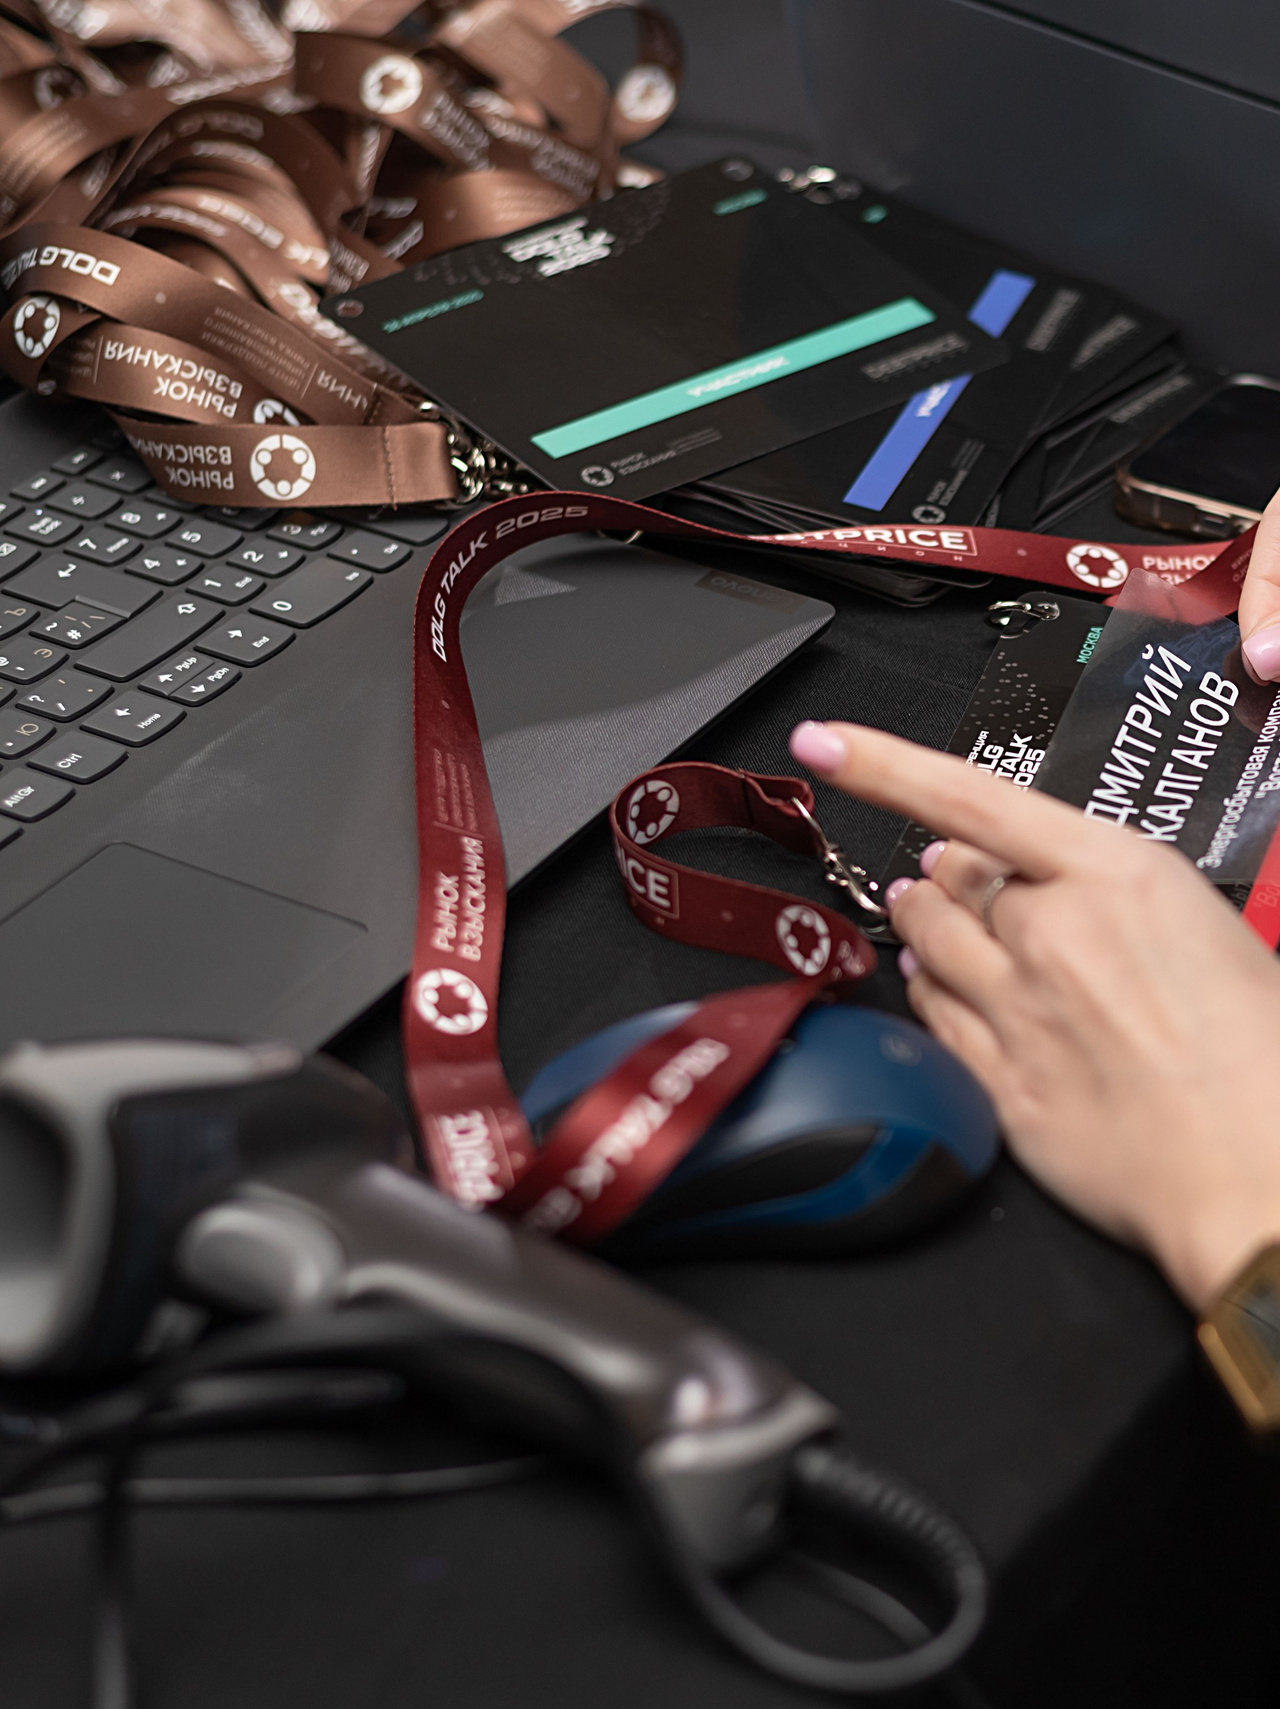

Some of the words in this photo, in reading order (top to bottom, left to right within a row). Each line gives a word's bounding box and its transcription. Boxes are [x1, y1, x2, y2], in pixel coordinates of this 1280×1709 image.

[39, 246, 121, 286] DOLG
[104, 340, 243, 400] ВЗЫСКАНИЯ
[153, 376, 238, 419] РЫНОК
[131, 435, 233, 465] ВЗЫСКАНИ
[165, 466, 235, 490] РЫНОК
[78, 537, 97, 550] 7
[181, 530, 201, 543] 5
[143, 558, 161, 570] 4
[242, 550, 264, 563] 2
[204, 578, 221, 588] 1
[431, 592, 447, 663] DOLG
[440, 530, 489, 595] TALK
[495, 506, 589, 541] 2025
[272, 600, 292, 611] 0
[252, 636, 270, 648] End
[1076, 627, 1103, 664] МОСКВА
[175, 656, 197, 672] PgUp
[207, 667, 230, 682] PgDn
[16, 723, 39, 737] Ю
[137, 712, 161, 729] Home
[1083, 643, 1192, 829] ДМИТРИЙ
[58, 753, 82, 769] Ctrl
[994, 733, 1033, 779] TALK
[1137, 671, 1239, 842] КАЛГАНОВ
[4, 786, 36, 808] AltGr
[1196, 745, 1271, 869] Энергосбытовая
[459, 836, 487, 962] ВЗЫСКАНИЯ
[432, 870, 459, 953] РЫНОК
